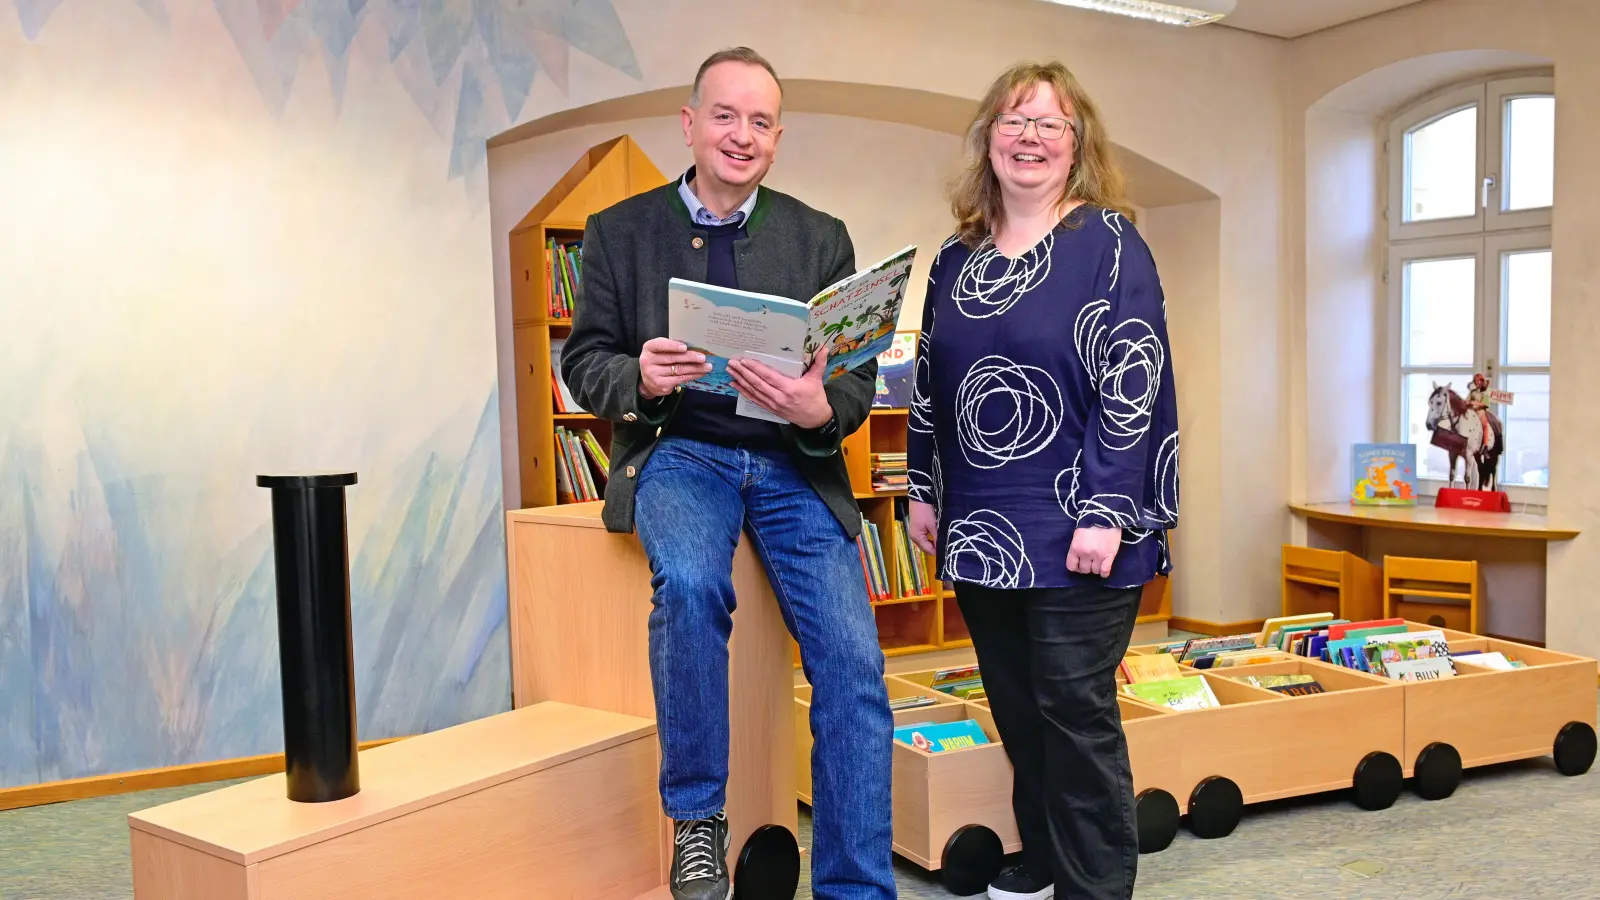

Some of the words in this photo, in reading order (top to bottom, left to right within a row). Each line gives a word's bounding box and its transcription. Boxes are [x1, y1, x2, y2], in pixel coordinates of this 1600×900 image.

[876, 348, 904, 359] ND
[1415, 669, 1440, 681] BILLY
[938, 735, 976, 751] WARUM
